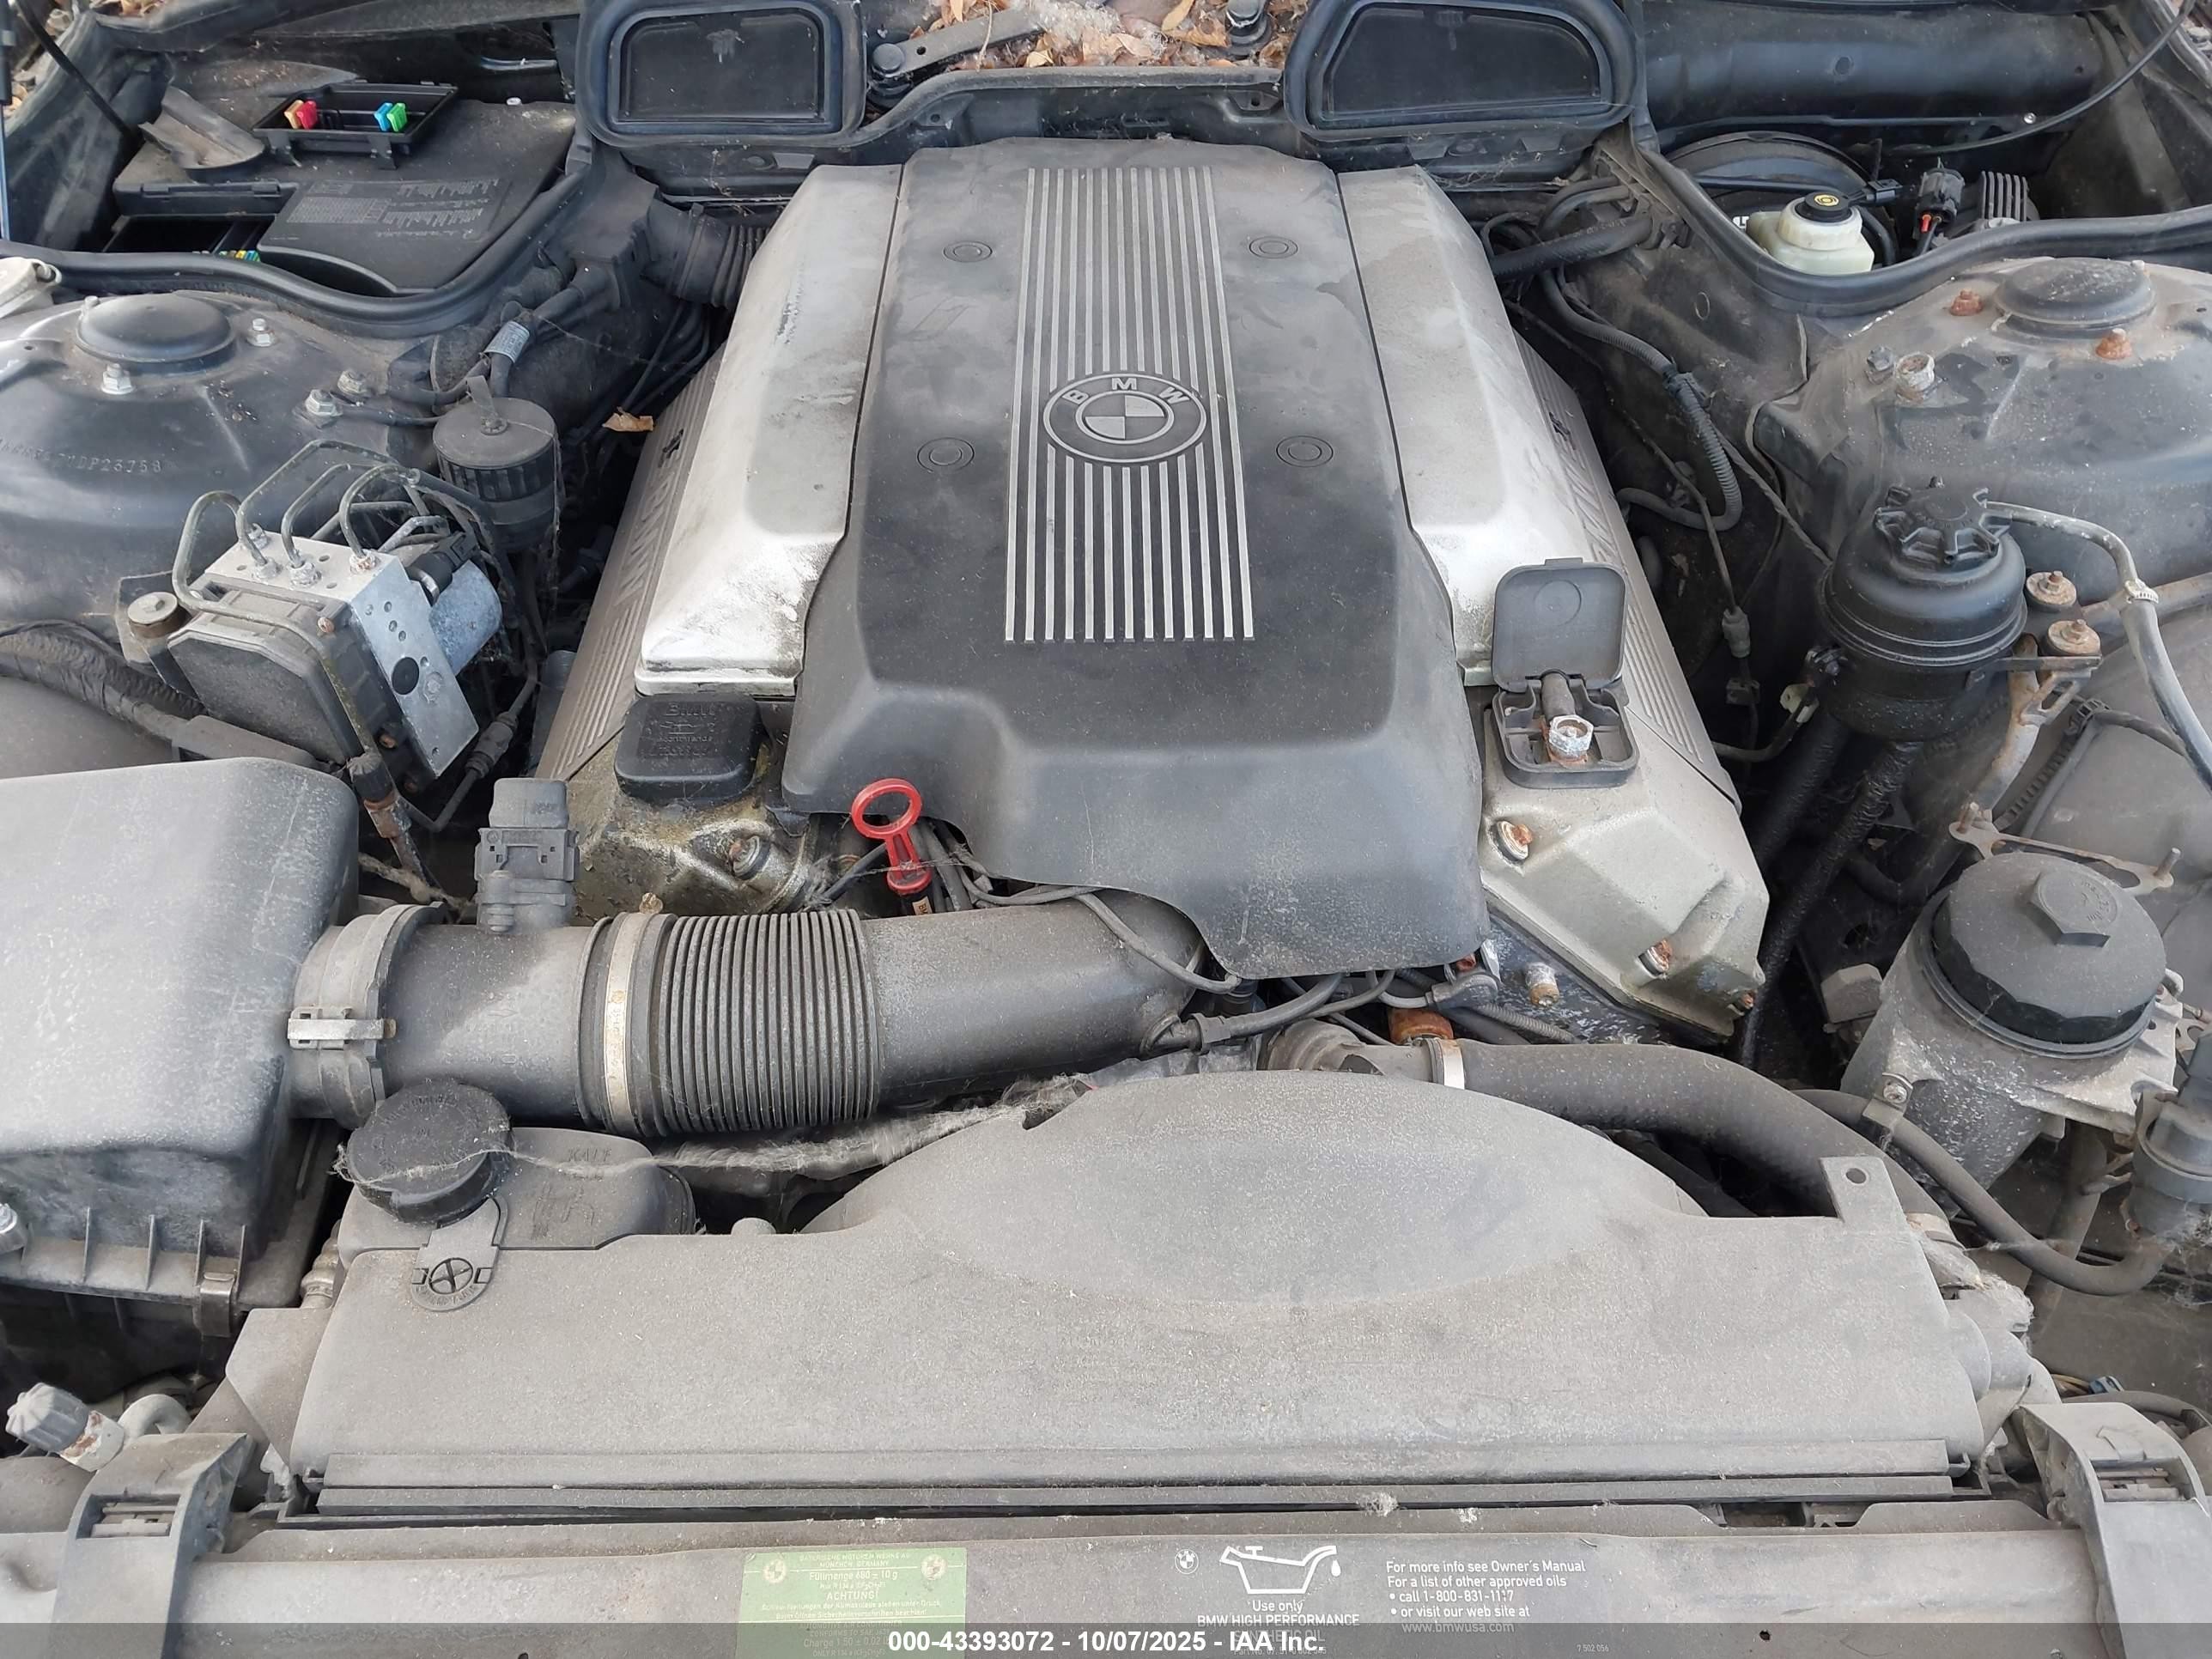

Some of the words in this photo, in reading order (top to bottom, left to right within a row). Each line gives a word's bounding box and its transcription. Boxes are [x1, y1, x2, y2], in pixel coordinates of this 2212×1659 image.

[1062, 378, 1190, 404] BMW
[1386, 1560, 1407, 1573] For
[1408, 1563, 1440, 1573] more
[1443, 1560, 1465, 1573] info
[1468, 1562, 1489, 1572] see
[1542, 1559, 1587, 1572] Manual
[809, 1571, 854, 1582] Füllmenge
[855, 1570, 871, 1579] 680
[892, 1571, 899, 1581] g
[1388, 1575, 1408, 1588] For
[1410, 1578, 1418, 1588] a
[1420, 1575, 1439, 1588] list
[1442, 1575, 1453, 1587] of
[1455, 1575, 1486, 1587] other
[1489, 1574, 1543, 1589] approved
[1546, 1574, 1567, 1587] oils
[826, 1590, 879, 1601] ACHTUNG!
[1399, 1589, 1421, 1602] call
[1423, 1589, 1514, 1602] 1-800-831-1117
[1252, 1600, 1275, 1612] Use
[1278, 1599, 1304, 1614] only
[1401, 1607, 1413, 1618] or
[1416, 1605, 1441, 1618] visit
[1443, 1607, 1464, 1618] our
[1467, 1604, 1492, 1617] web
[1494, 1605, 1516, 1617] site
[1518, 1605, 1530, 1617] at
[1197, 1614, 1229, 1627] BMW
[1231, 1614, 1262, 1627] HIGH
[1265, 1613, 1361, 1627] PERFORMANCE
[1401, 1620, 1515, 1632] www.bmwusa.com
